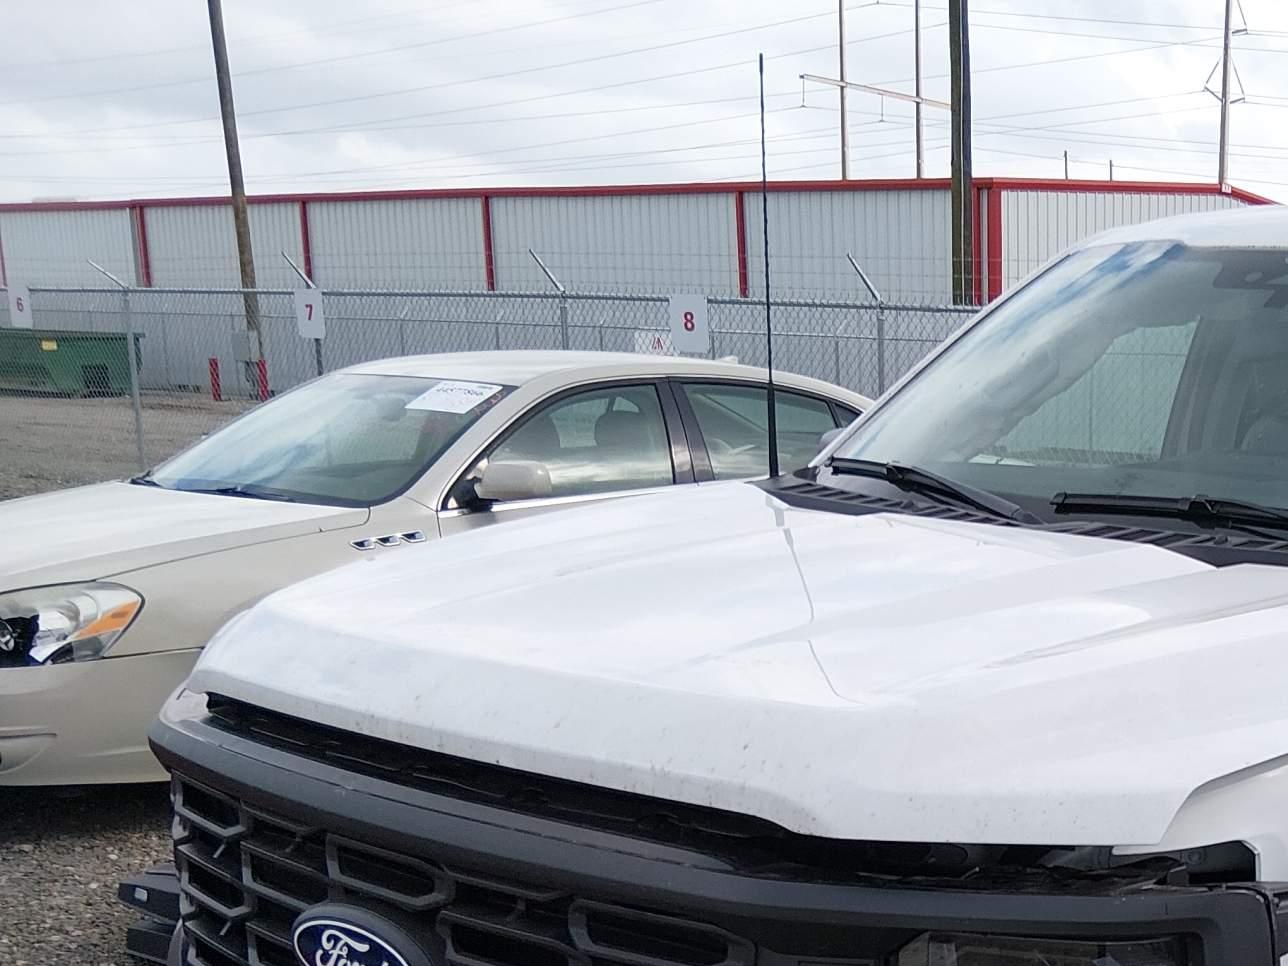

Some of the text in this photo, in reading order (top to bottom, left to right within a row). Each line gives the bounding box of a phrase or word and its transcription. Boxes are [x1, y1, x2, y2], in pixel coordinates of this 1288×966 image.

[16, 297, 24, 312] 6
[304, 304, 314, 321] 7
[683, 311, 695, 332] 8
